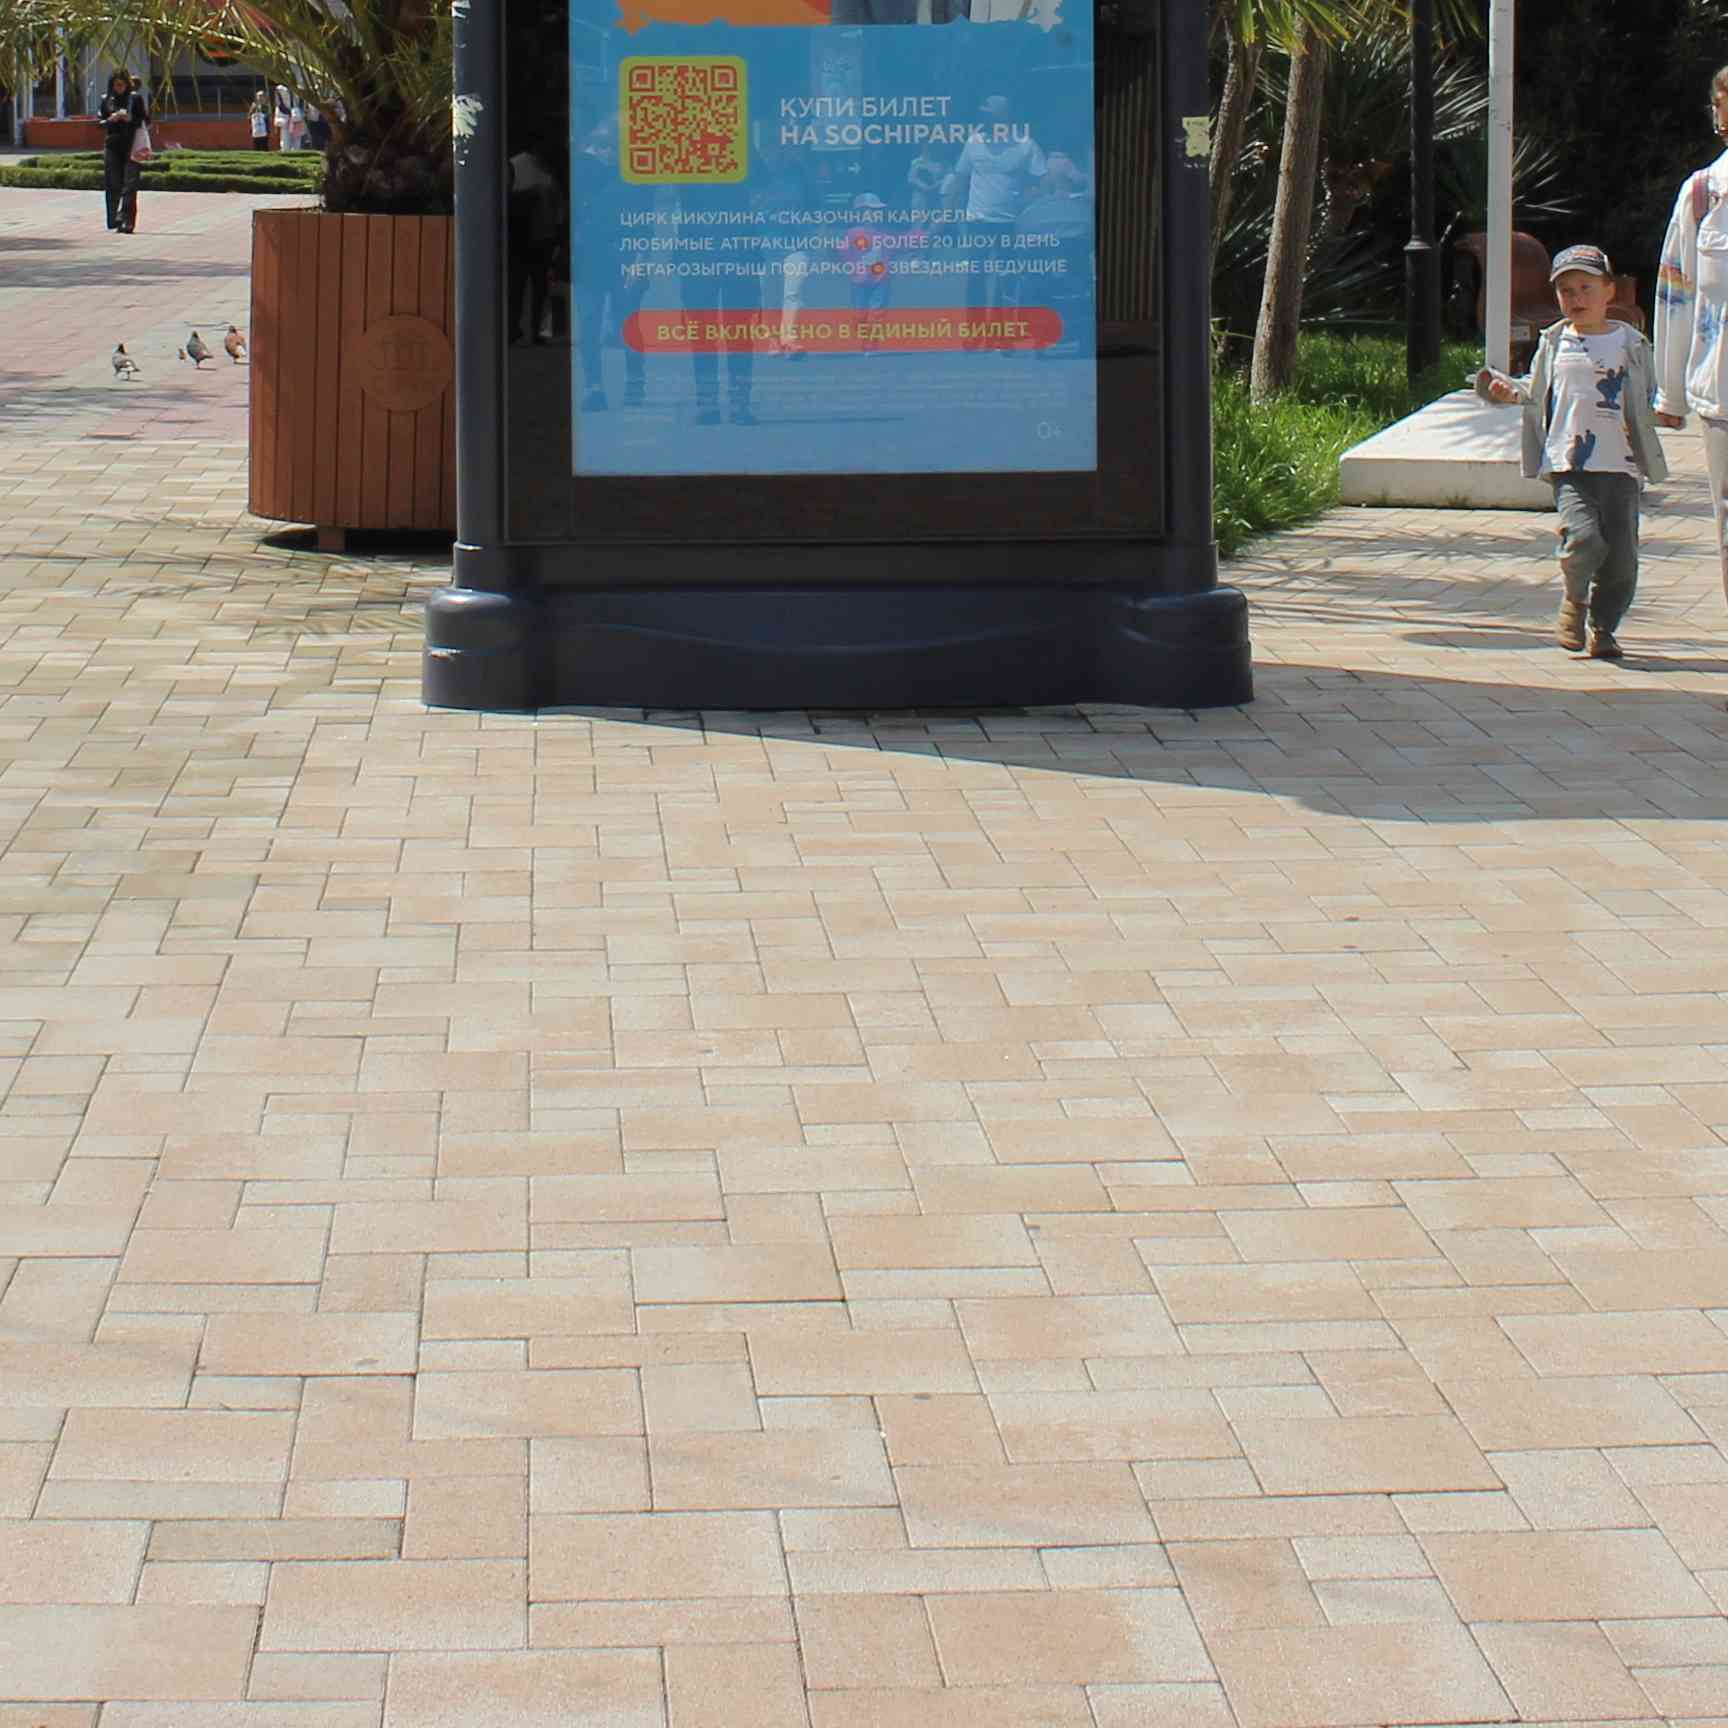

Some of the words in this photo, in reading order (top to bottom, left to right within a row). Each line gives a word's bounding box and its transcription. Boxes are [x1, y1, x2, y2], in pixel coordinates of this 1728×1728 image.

[780, 97, 855, 119] КУПИ
[862, 96, 952, 118] БИЛЕТ
[780, 124, 819, 146] НА
[824, 122, 1031, 146] SOCHIPARK.RU
[620, 211, 667, 228] ЦИРК
[671, 210, 766, 225] НИКУЛИНА
[619, 236, 714, 252] ЛЮБИМЫЕ
[720, 235, 850, 252] АТТРАКЦИОНЫ
[872, 234, 929, 250] БОЛЕЕ
[933, 234, 953, 249] 20
[957, 233, 996, 249] ШОУ
[1000, 234, 1010, 248] В
[1014, 233, 1061, 250] ДЕНЬ
[621, 261, 767, 278] МЕГАРОЗЫГРЫШ
[771, 261, 867, 277] ПОДАРКОВ
[984, 258, 1069, 275] ВЕДУЩИЕ
[657, 320, 700, 341] ВСЁ
[705, 324, 833, 340] ВКЛЮЧЕНО
[839, 323, 850, 338] В
[857, 318, 952, 340] ЕДИНЫЙ
[959, 321, 1027, 337] БИЛЕТ
